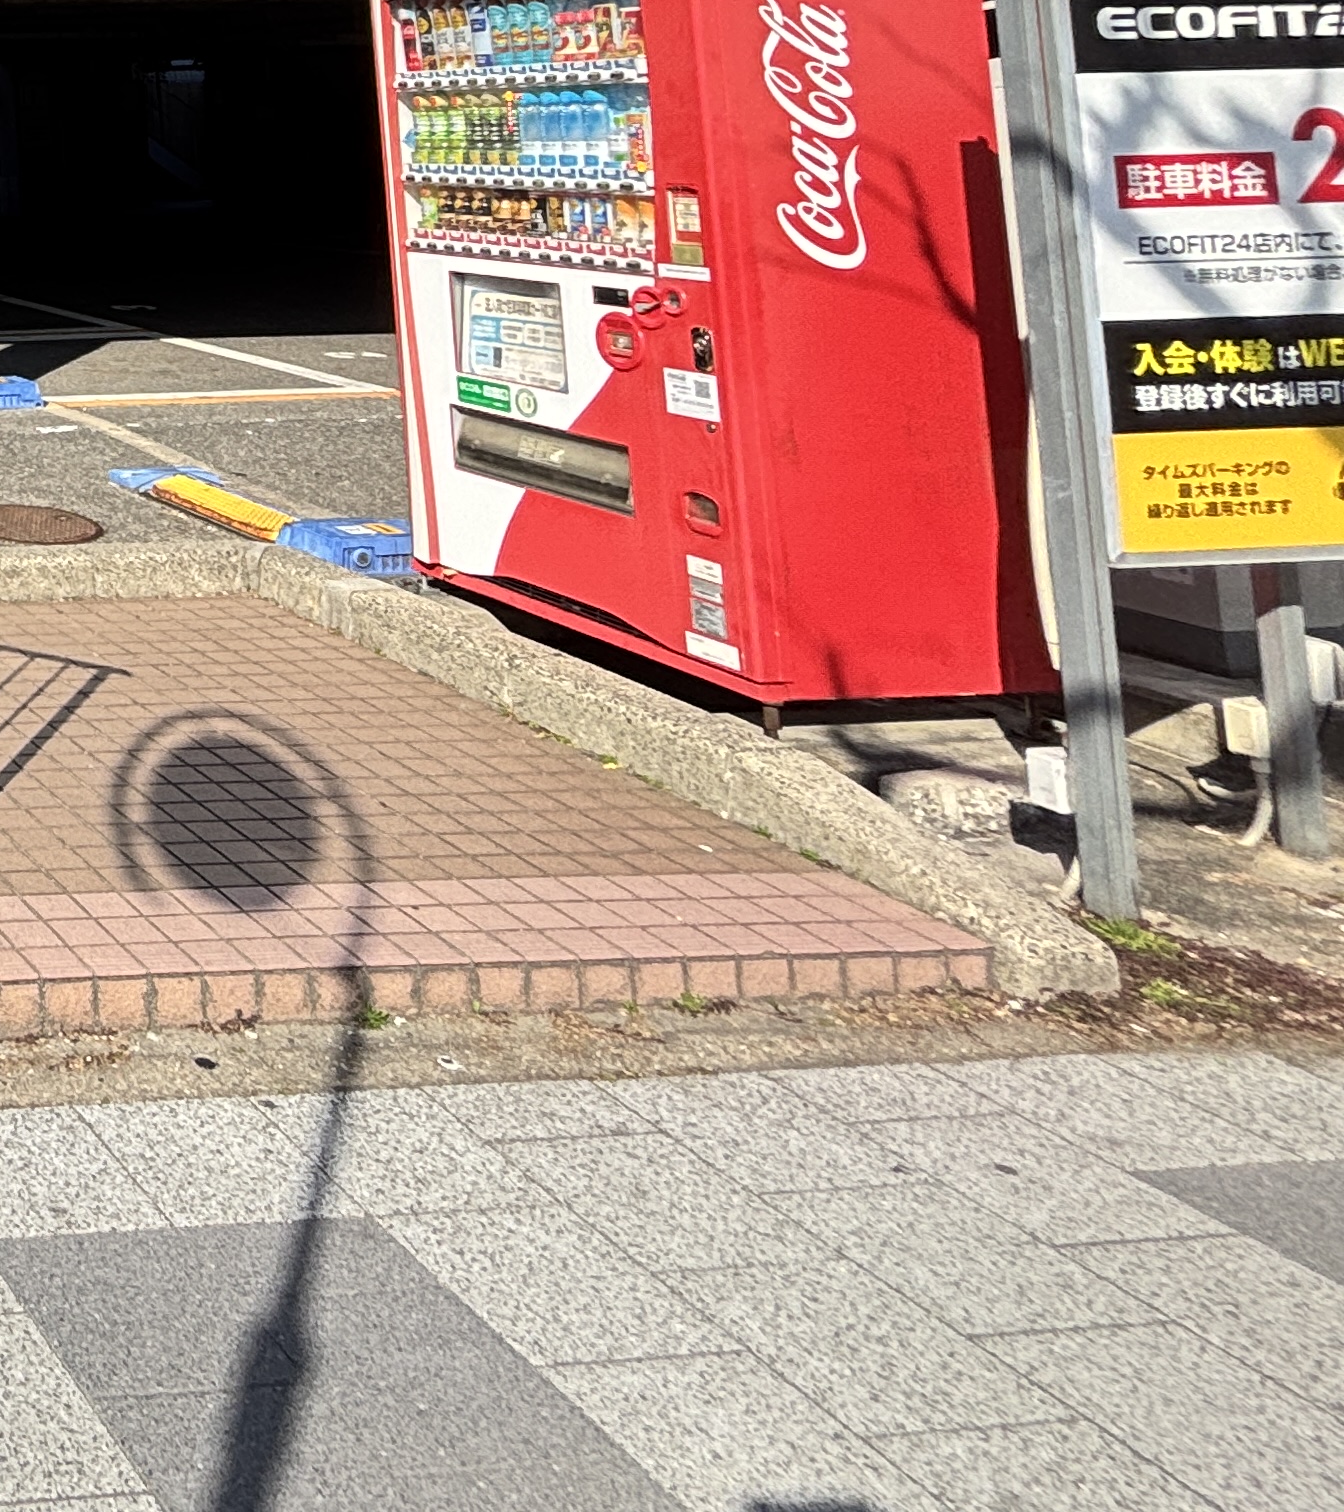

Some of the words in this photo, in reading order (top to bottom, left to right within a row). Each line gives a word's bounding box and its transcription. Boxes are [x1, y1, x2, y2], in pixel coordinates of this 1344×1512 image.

[1126, 160, 1269, 201] 駐車料金
[1134, 379, 1344, 413] 登録後すぐに利用可
